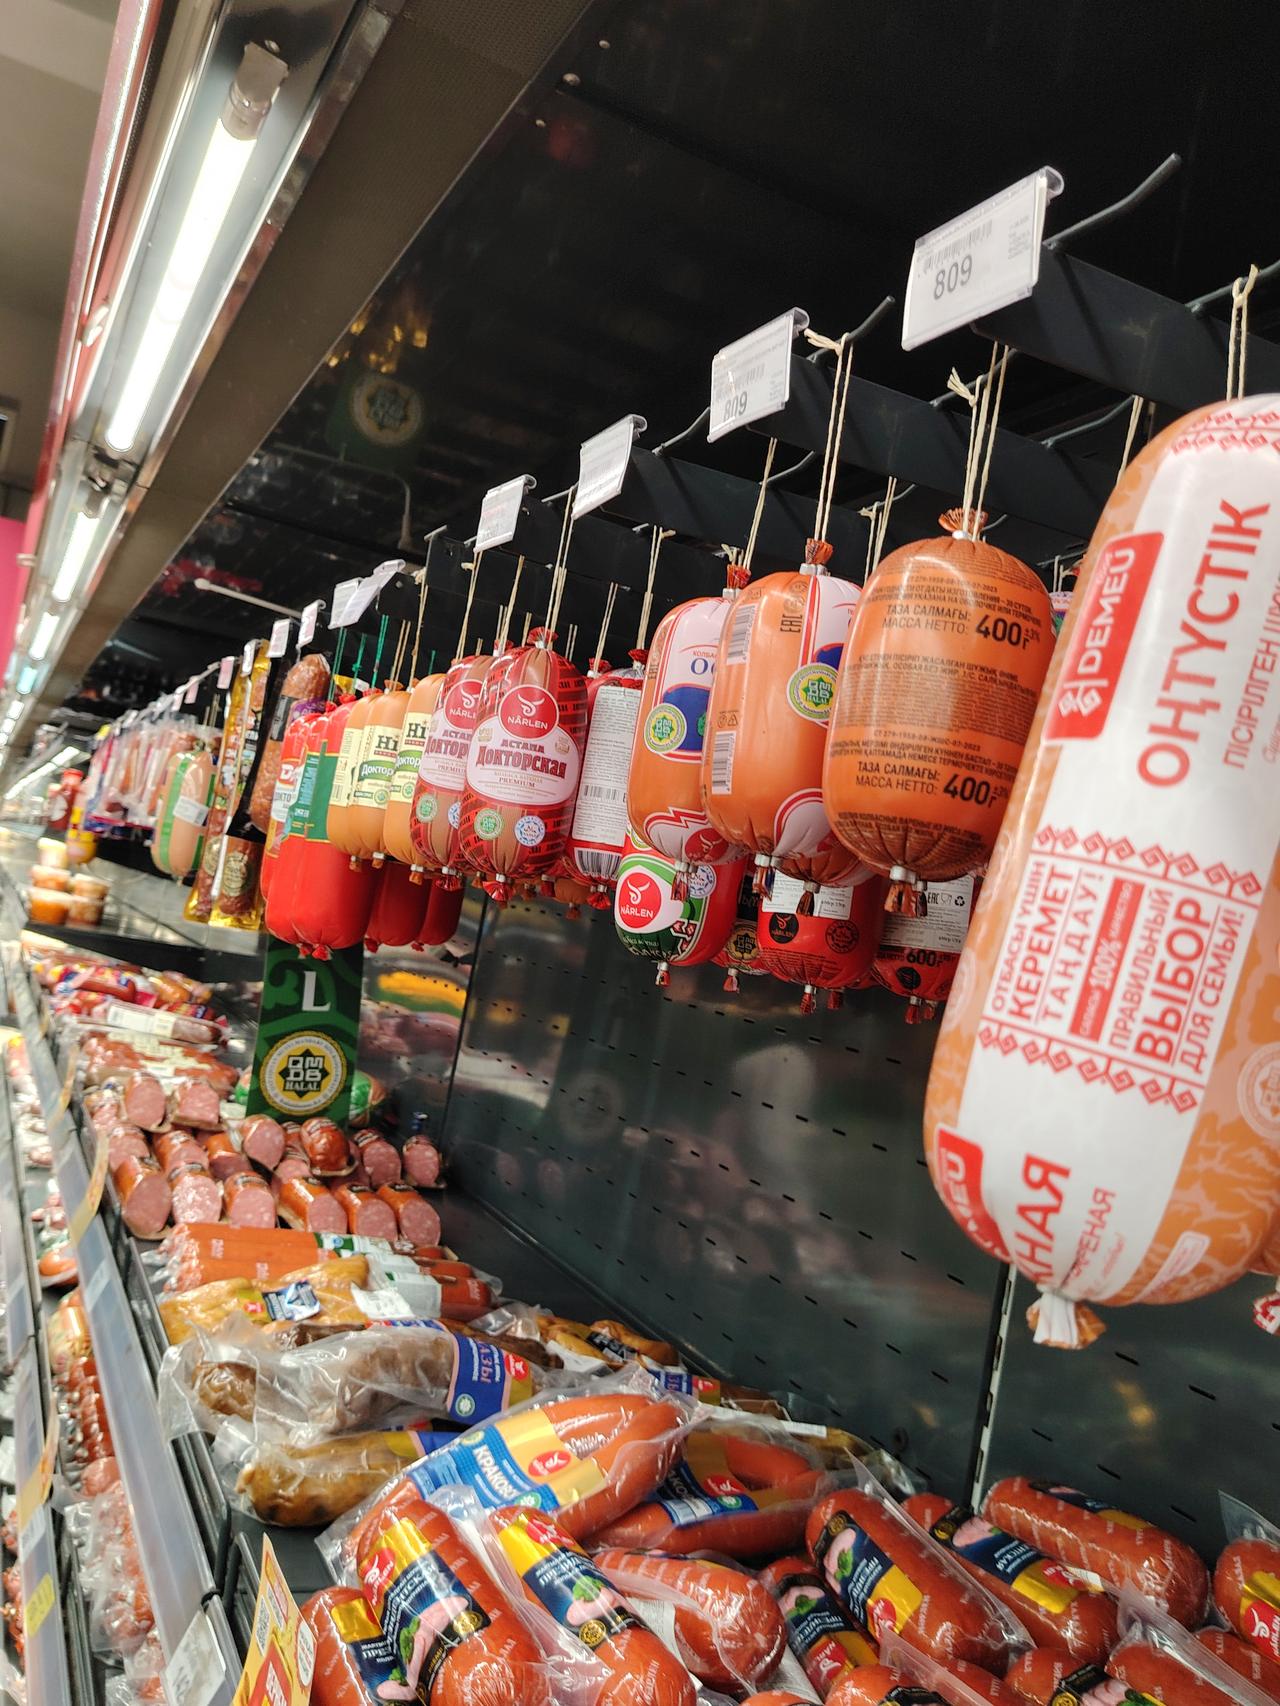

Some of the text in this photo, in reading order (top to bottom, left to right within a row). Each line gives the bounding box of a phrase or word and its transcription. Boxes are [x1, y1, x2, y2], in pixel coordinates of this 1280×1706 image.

[932, 254, 973, 301] 809
[881, 616, 969, 635] МАССА НЕТТО:
[886, 604, 910, 617] ТАЗА
[1077, 546, 1136, 676] DEMEU
[692, 650, 717, 659] КОЛБА
[855, 774, 938, 795] МАССА НЕТТО:
[857, 761, 881, 775] ТАЗА
[1006, 863, 1075, 1022] КЕРЕМЕТ
[991, 924, 1028, 1013] ОТБАСЫ
[1107, 886, 1175, 1051] ПРАВИЛЬНЫЙ
[1133, 896, 1211, 1065] ВЫБОР
[1180, 908, 1246, 1075] ДЛЯ СЕМЬИ!
[285, 1081, 320, 1091] HALAL
